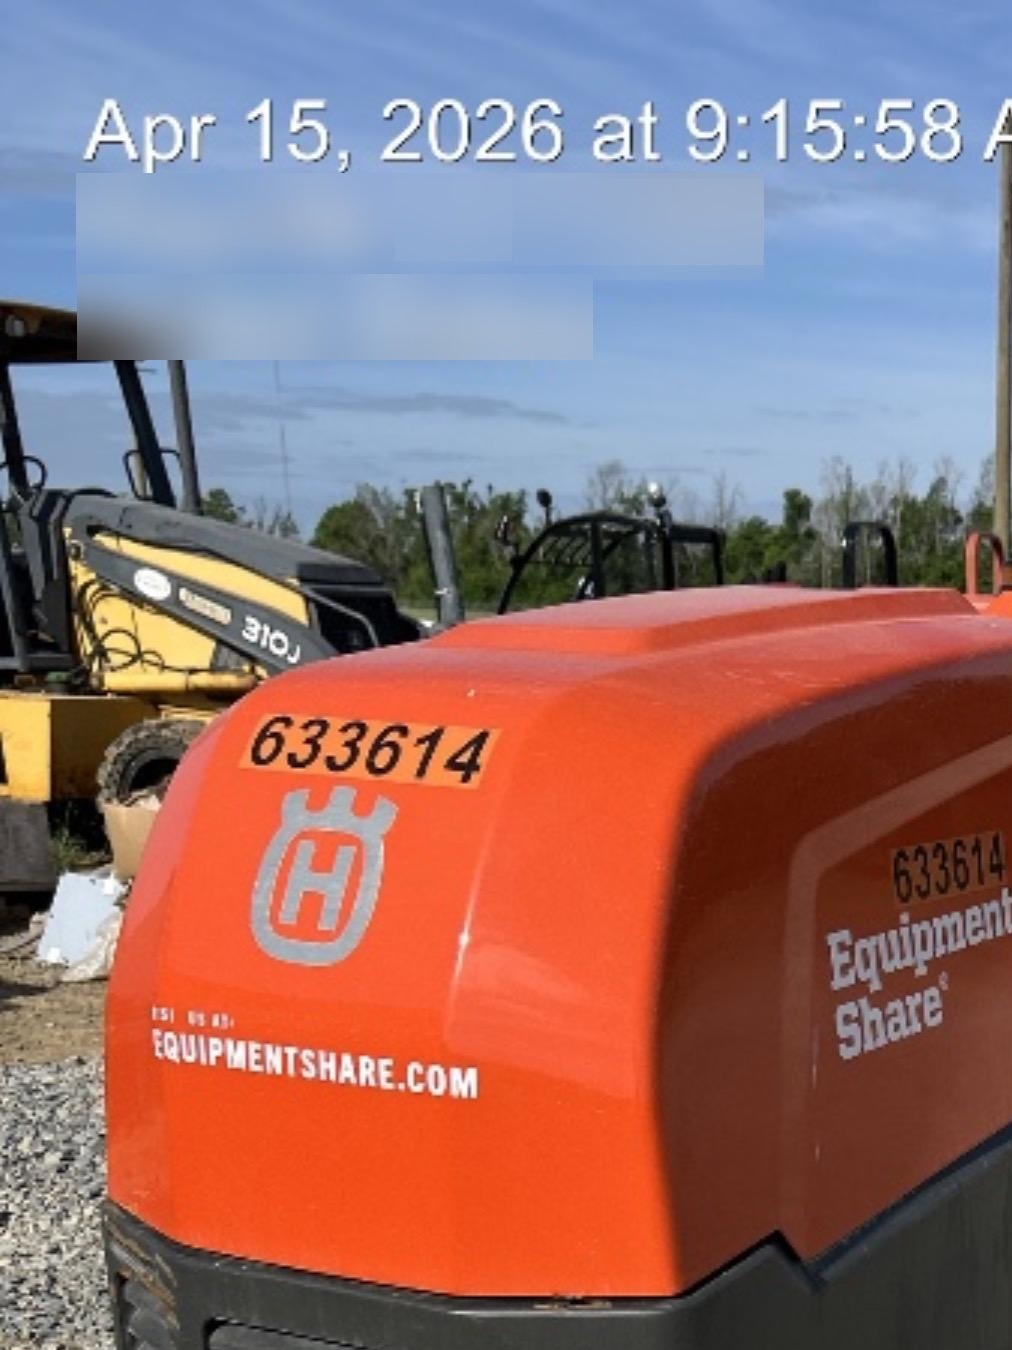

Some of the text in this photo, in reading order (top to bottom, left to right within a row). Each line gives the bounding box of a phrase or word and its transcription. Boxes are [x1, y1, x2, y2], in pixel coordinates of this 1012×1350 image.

[242, 615, 301, 664] 310J
[249, 715, 492, 785] 633614
[892, 832, 1006, 904] 633614
[151, 1028, 479, 1099] EQUIPMENTSHARE.COM
